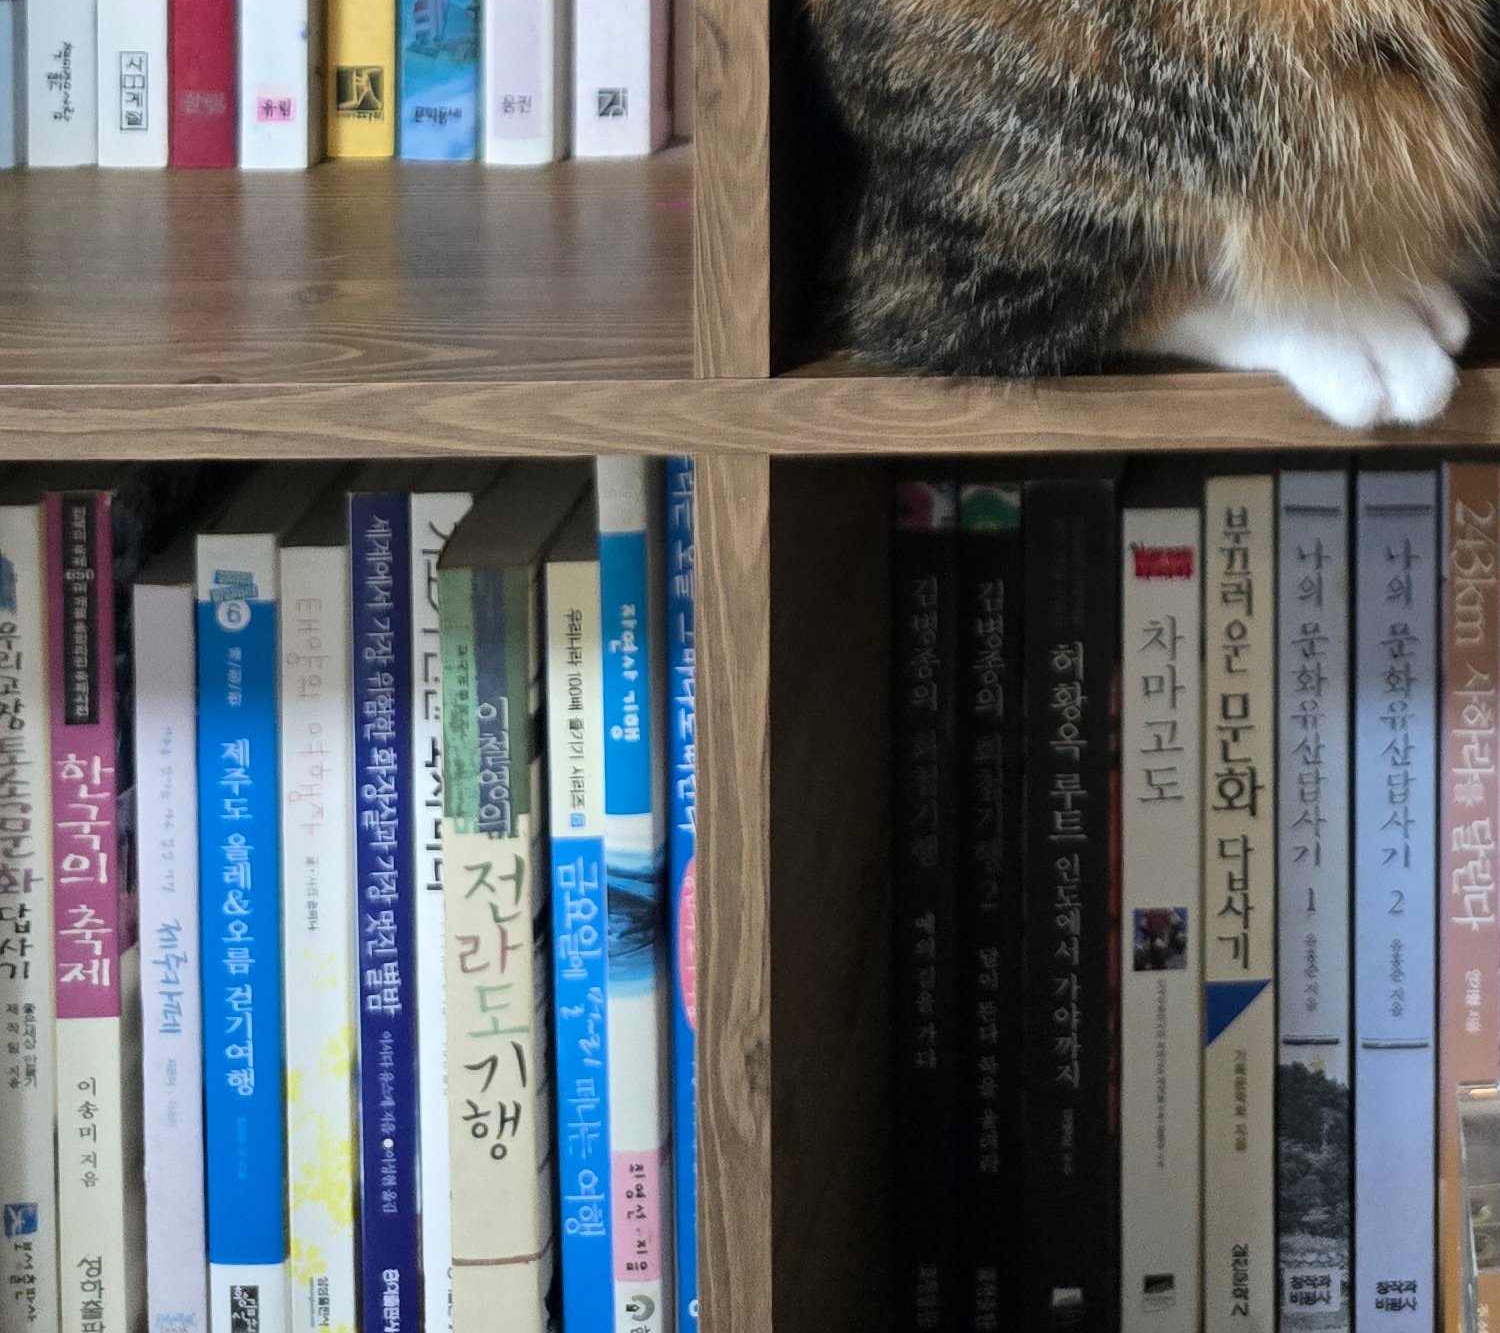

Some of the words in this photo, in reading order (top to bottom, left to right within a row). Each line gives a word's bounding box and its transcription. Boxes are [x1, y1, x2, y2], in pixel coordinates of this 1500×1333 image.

[362, 515, 397, 610] 세계에서
[1218, 504, 1256, 677] 부끄러운
[1296, 537, 1331, 609] 나의
[1384, 537, 1420, 610] 나의
[362, 617, 397, 664] 가장
[565, 607, 585, 667] 우리나라
[361, 671, 398, 741] 위험한
[565, 671, 585, 711] 100배
[1136, 614, 1186, 805] 차마고도
[565, 717, 585, 760] 즐기기
[1211, 691, 1265, 818] 문화
[1290, 621, 1330, 869] 문화유산답사기
[1379, 621, 1418, 870] 문화유산답사기
[219, 737, 254, 821] 제주도
[360, 747, 398, 850] 화장실과
[565, 766, 585, 810] 시리즈
[1048, 772, 1089, 842] 루트
[55, 752, 114, 886] 한국의
[363, 855, 399, 903] 가장
[1216, 833, 1257, 971] 답사기
[1304, 886, 1318, 914] 1
[1388, 888, 1406, 915] 2
[56, 903, 113, 987] 축제
[365, 909, 400, 957] 멋진
[556, 854, 602, 979] 금요일에
[365, 961, 402, 1014] 별밤
[378, 1030, 395, 1068] 이시다
[1050, 974, 1084, 1090] 가야까지
[78, 1075, 98, 1144] 이송미
[378, 1071, 395, 1108] 유스케
[378, 1111, 396, 1134] 지음
[79, 1153, 98, 1188] 지음
[562, 1167, 607, 1238] 여행
[625, 1238, 648, 1273] 지음
[1291, 1274, 1332, 1290] 창작과
[1375, 1278, 1418, 1296] 창작과
